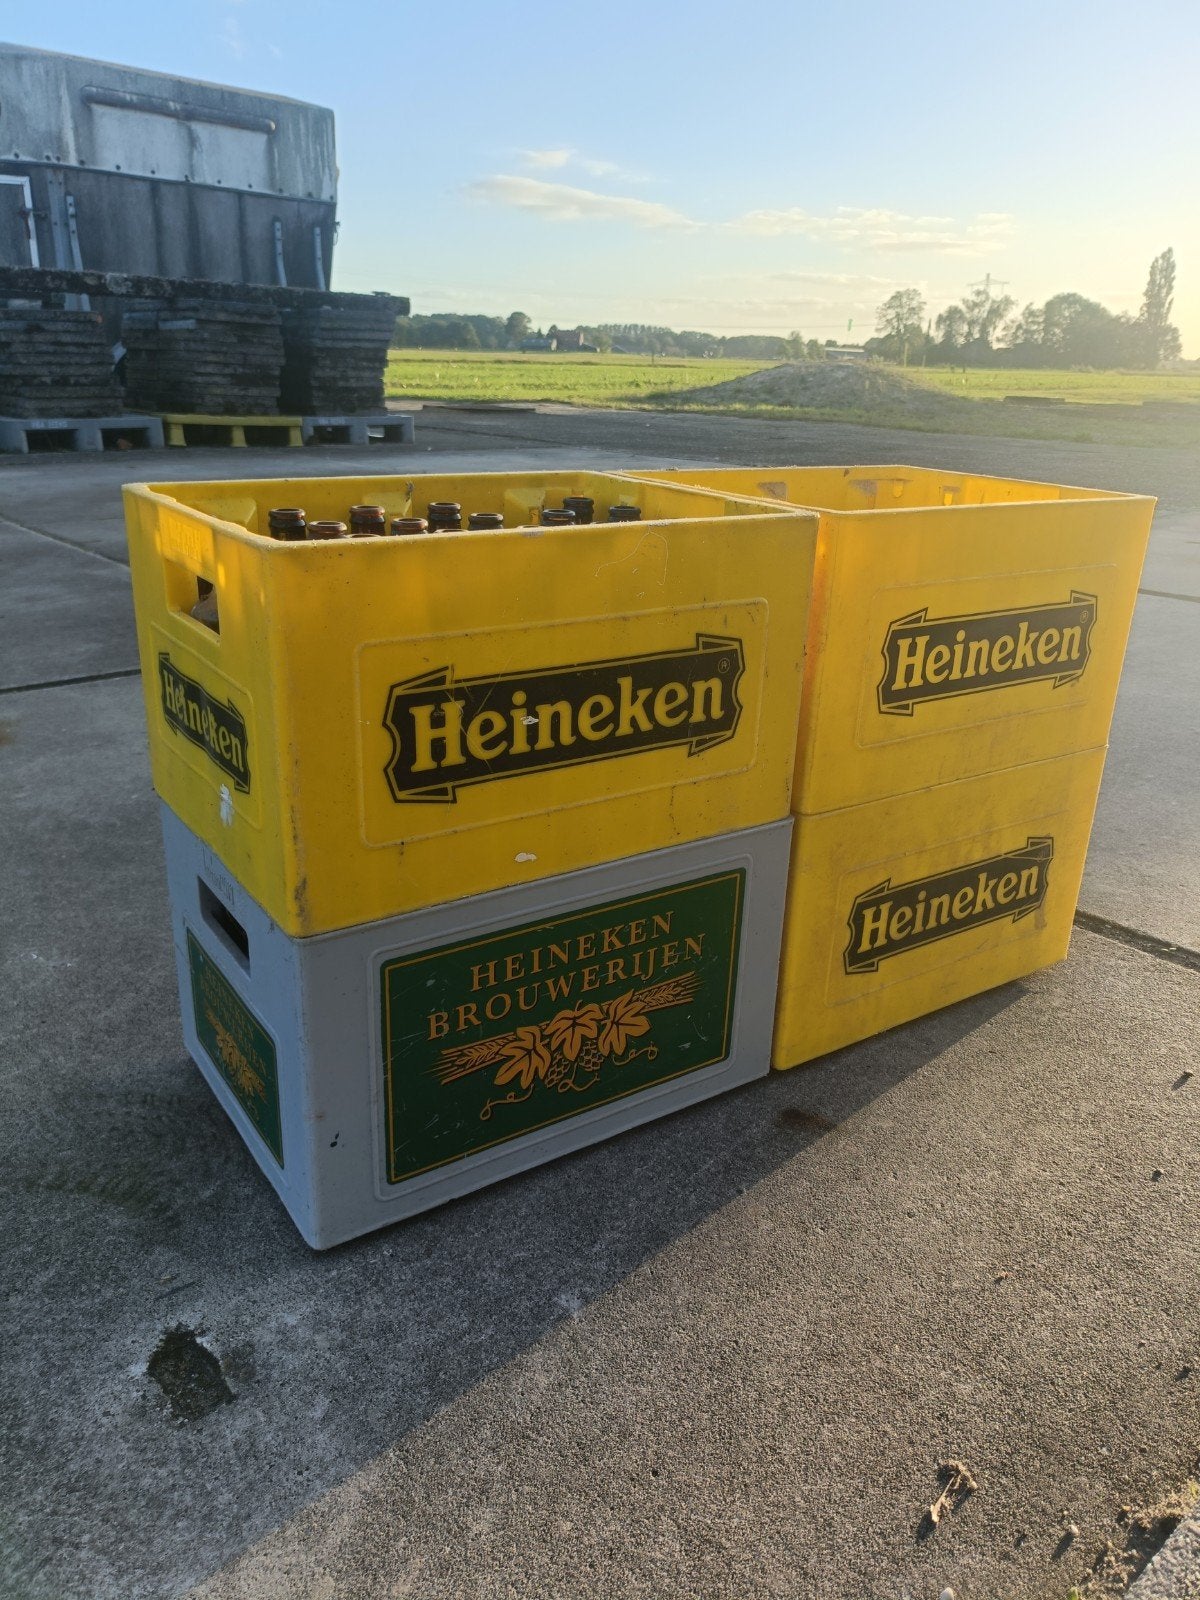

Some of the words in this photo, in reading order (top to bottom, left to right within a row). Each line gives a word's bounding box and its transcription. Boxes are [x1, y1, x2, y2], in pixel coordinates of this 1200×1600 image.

[890, 622, 1081, 691] Heineken
[162, 666, 246, 771] Heineken
[408, 675, 726, 773] Heineken
[469, 911, 675, 992] HEINEKEN
[856, 864, 1039, 954] Heineken
[426, 933, 707, 1041] BROUWERIJEN
